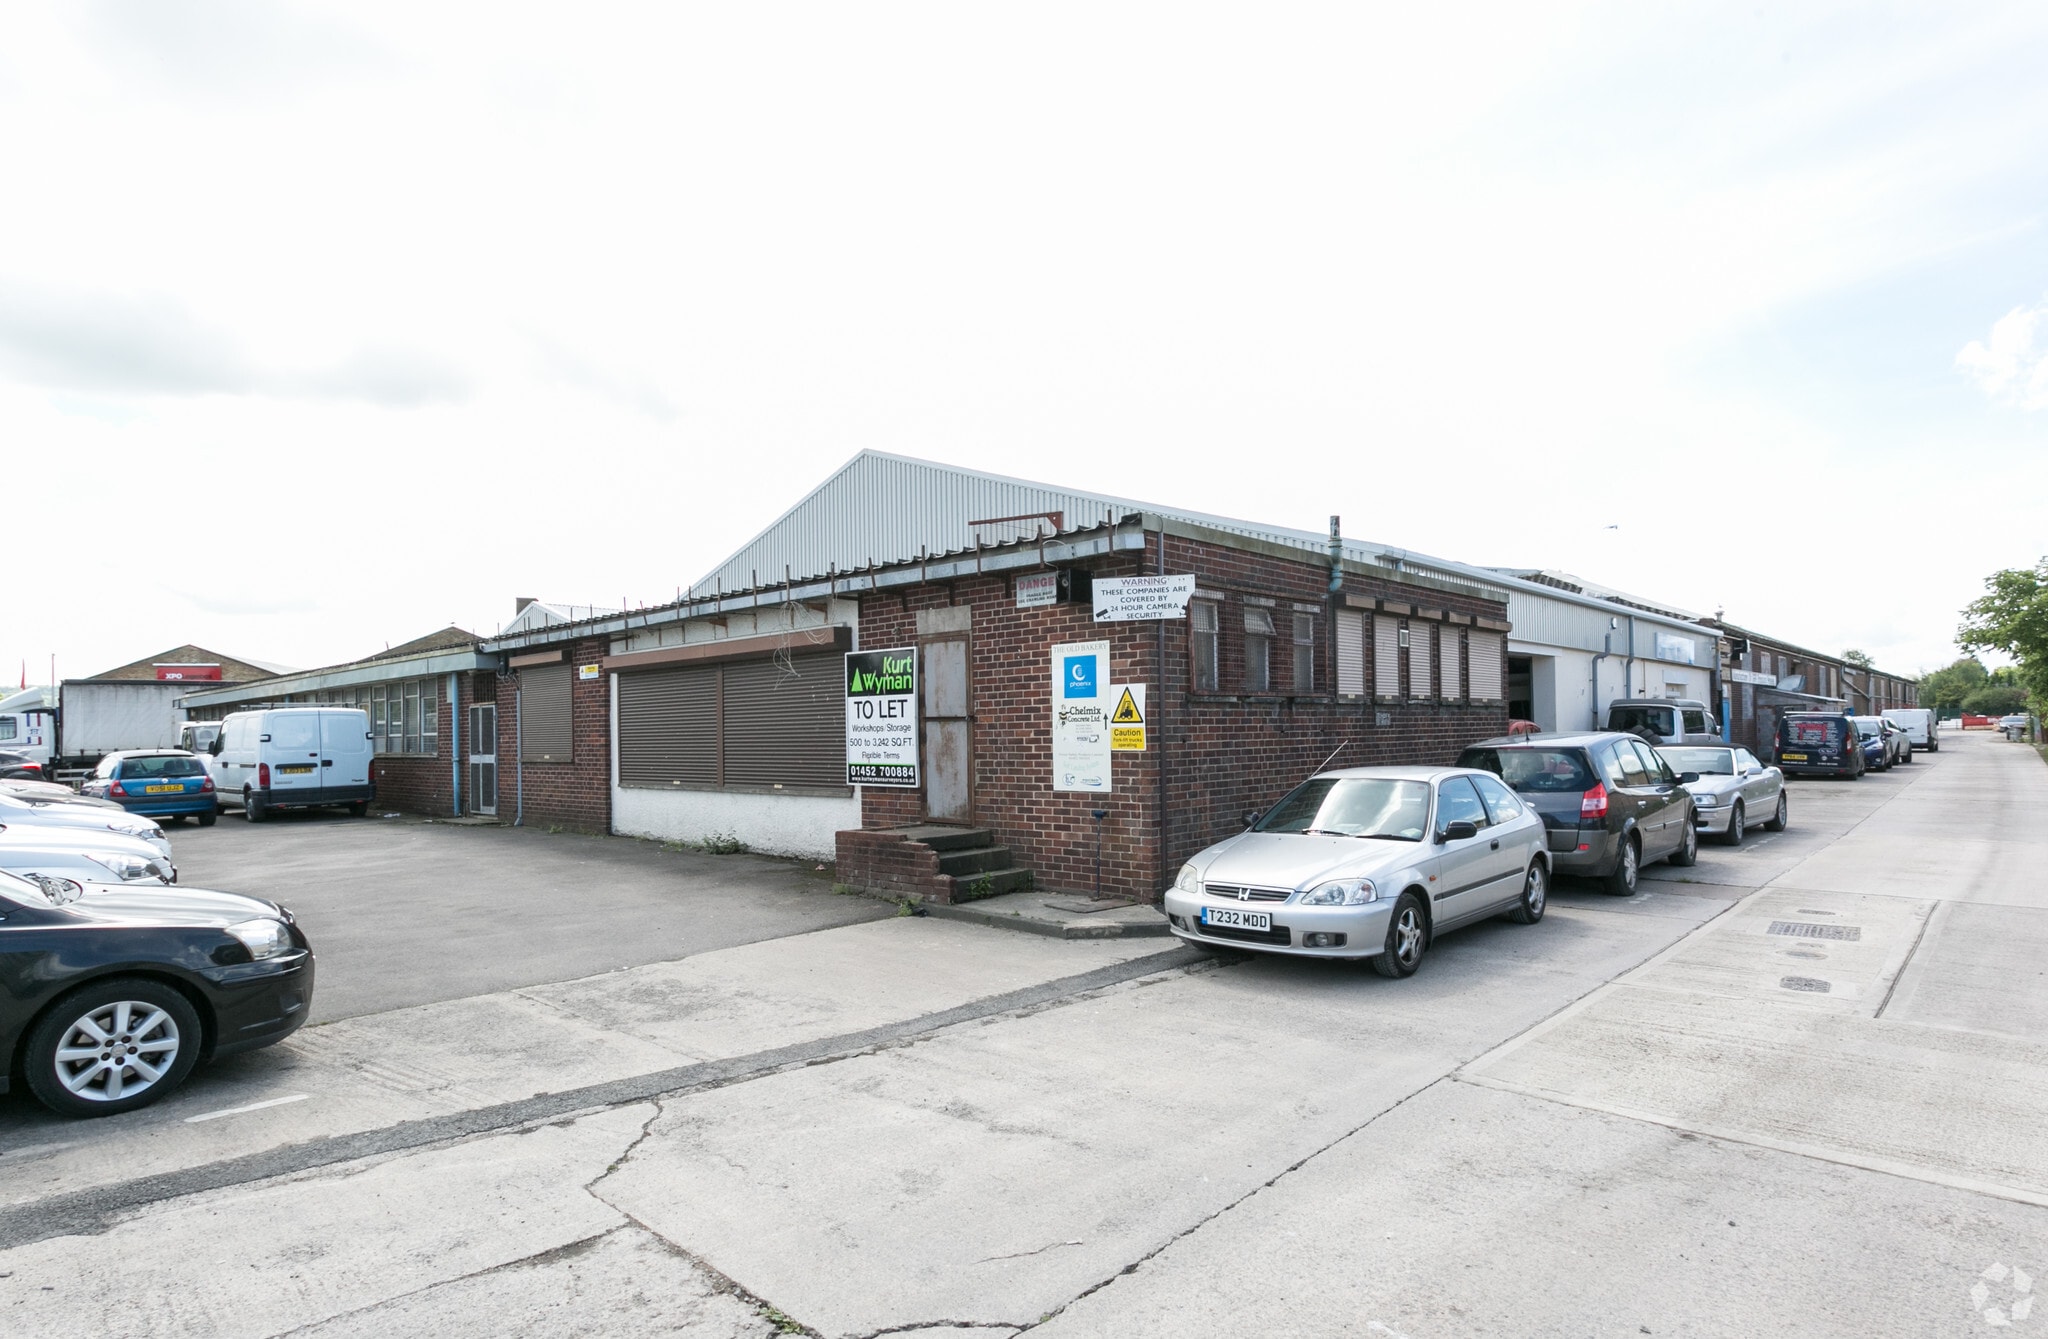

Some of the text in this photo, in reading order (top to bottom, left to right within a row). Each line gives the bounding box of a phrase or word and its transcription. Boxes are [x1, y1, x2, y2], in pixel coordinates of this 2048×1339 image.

[1018, 576, 1055, 591] DANGE
[1121, 577, 1167, 586] WARNING
[1126, 587, 1169, 595] COMPANIES
[1173, 585, 1188, 593] ARE
[1146, 602, 1179, 610] CAMERA
[1066, 644, 1080, 652] OLD
[1082, 643, 1107, 651] BAKERY
[883, 656, 913, 674] Kurt
[862, 673, 913, 694] Wyman
[1070, 681, 1092, 689] phoenix
[854, 699, 909, 719] TO LET
[1070, 706, 1102, 715] Chelmix
[852, 723, 912, 733] Workshops Storage
[1113, 728, 1141, 737] Caution
[850, 738, 863, 746] 500
[864, 738, 871, 746] to
[862, 751, 901, 760] Flexible Terms
[850, 765, 914, 777] 01452 700884
[1209, 910, 1267, 928] T232 MDD
